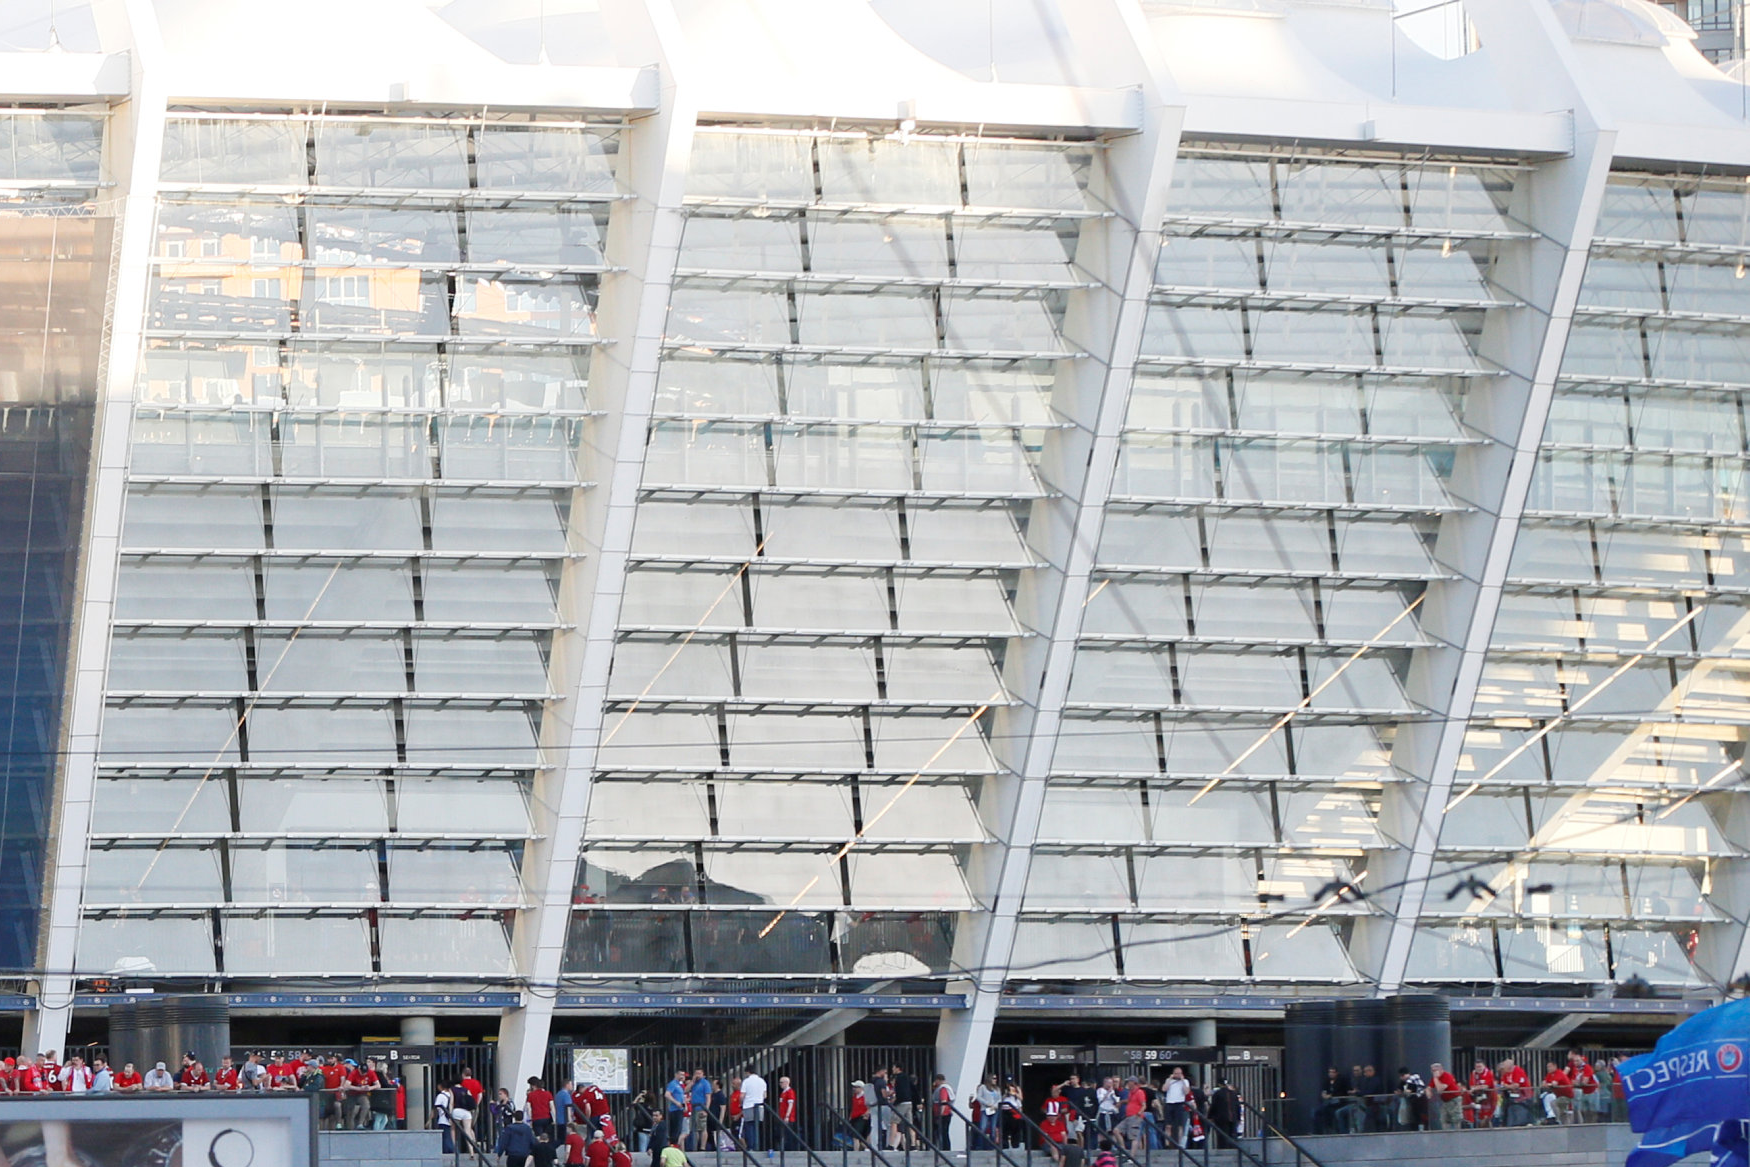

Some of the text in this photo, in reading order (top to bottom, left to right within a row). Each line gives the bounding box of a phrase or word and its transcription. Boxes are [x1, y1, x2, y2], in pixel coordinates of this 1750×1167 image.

[1144, 1051, 1157, 1060] 59
[1159, 1051, 1172, 1060] 60
[48, 1070, 57, 1083] 6
